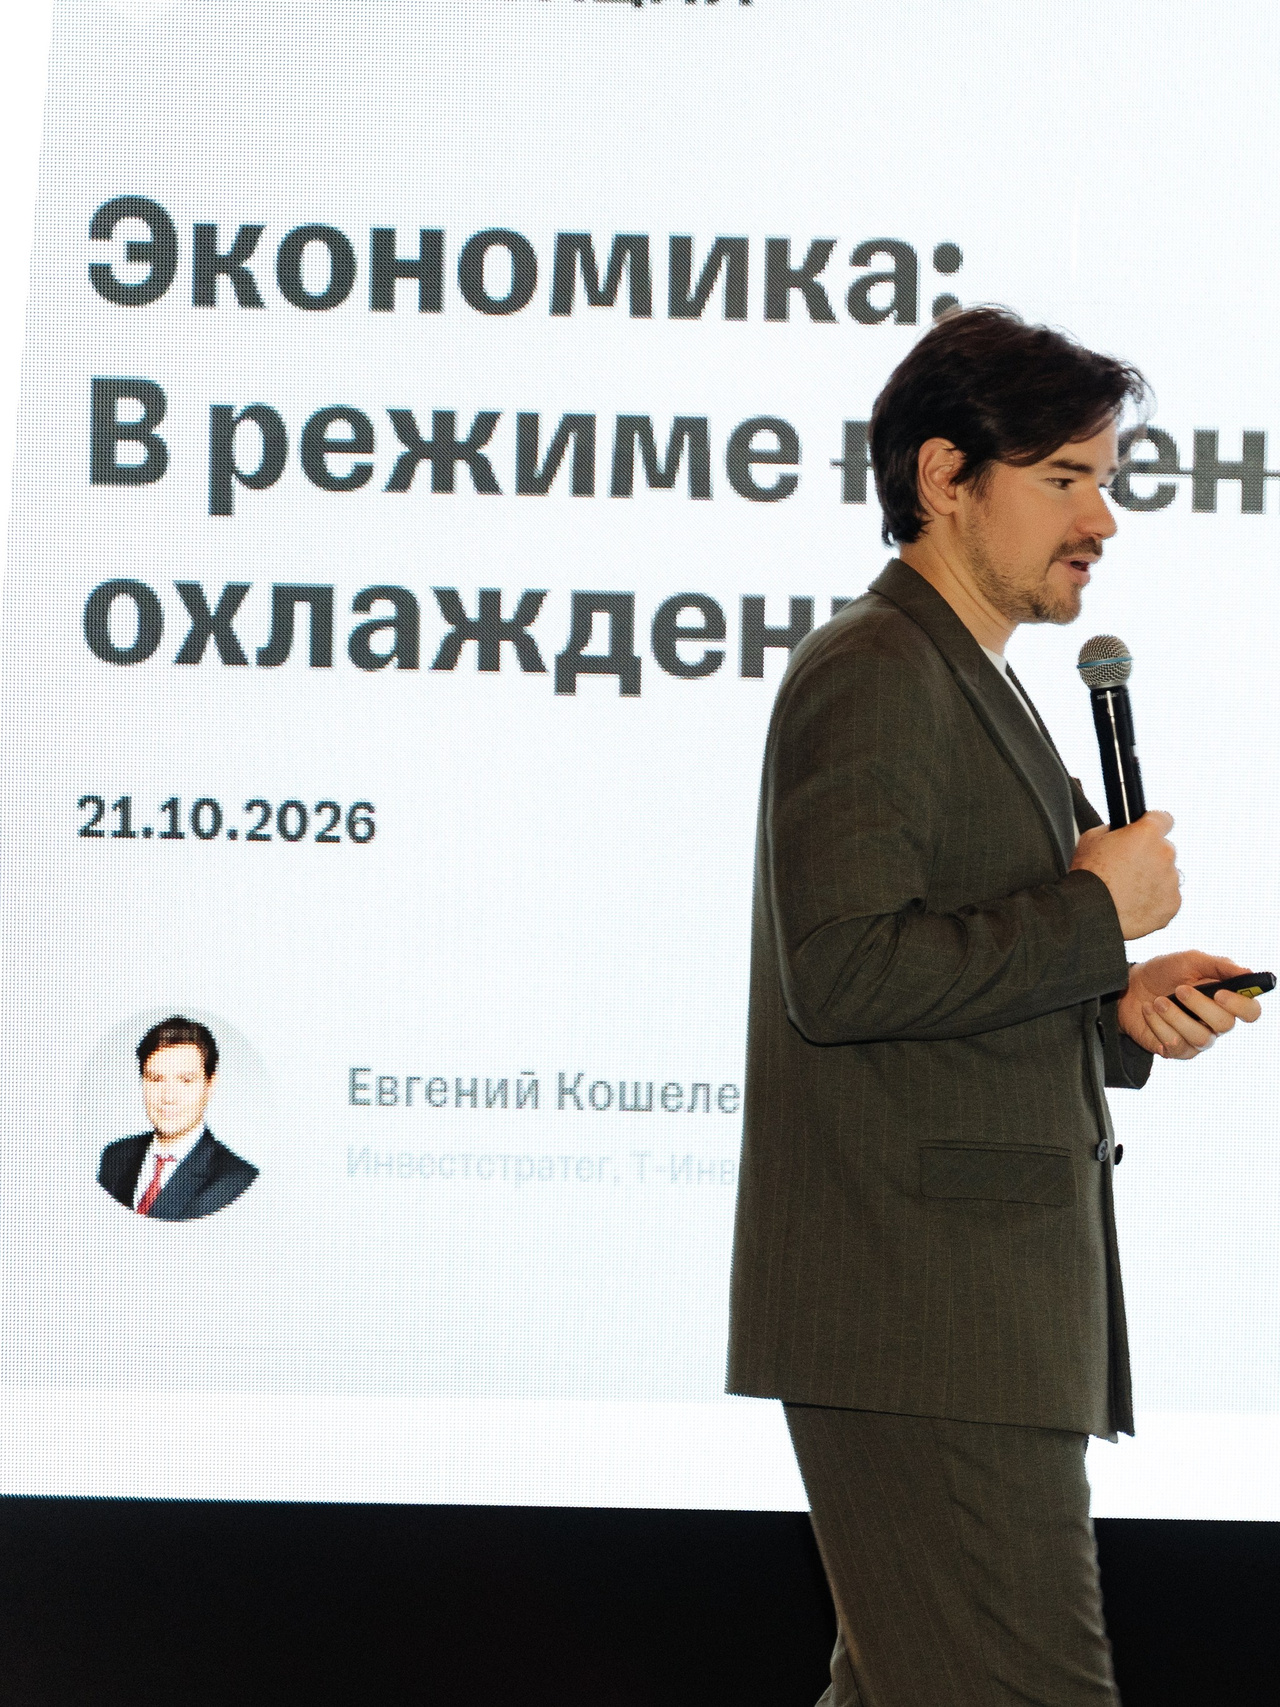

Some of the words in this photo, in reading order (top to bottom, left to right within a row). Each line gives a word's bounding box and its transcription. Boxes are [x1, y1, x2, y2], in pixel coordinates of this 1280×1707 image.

[88, 195, 965, 325] Экономика:
[89, 376, 170, 486] В
[208, 403, 802, 517] режиме
[83, 578, 856, 697] охлажден
[77, 794, 377, 845] 21.10.2026
[348, 1066, 541, 1110] Евгений
[556, 1071, 741, 1114] Кошеле
